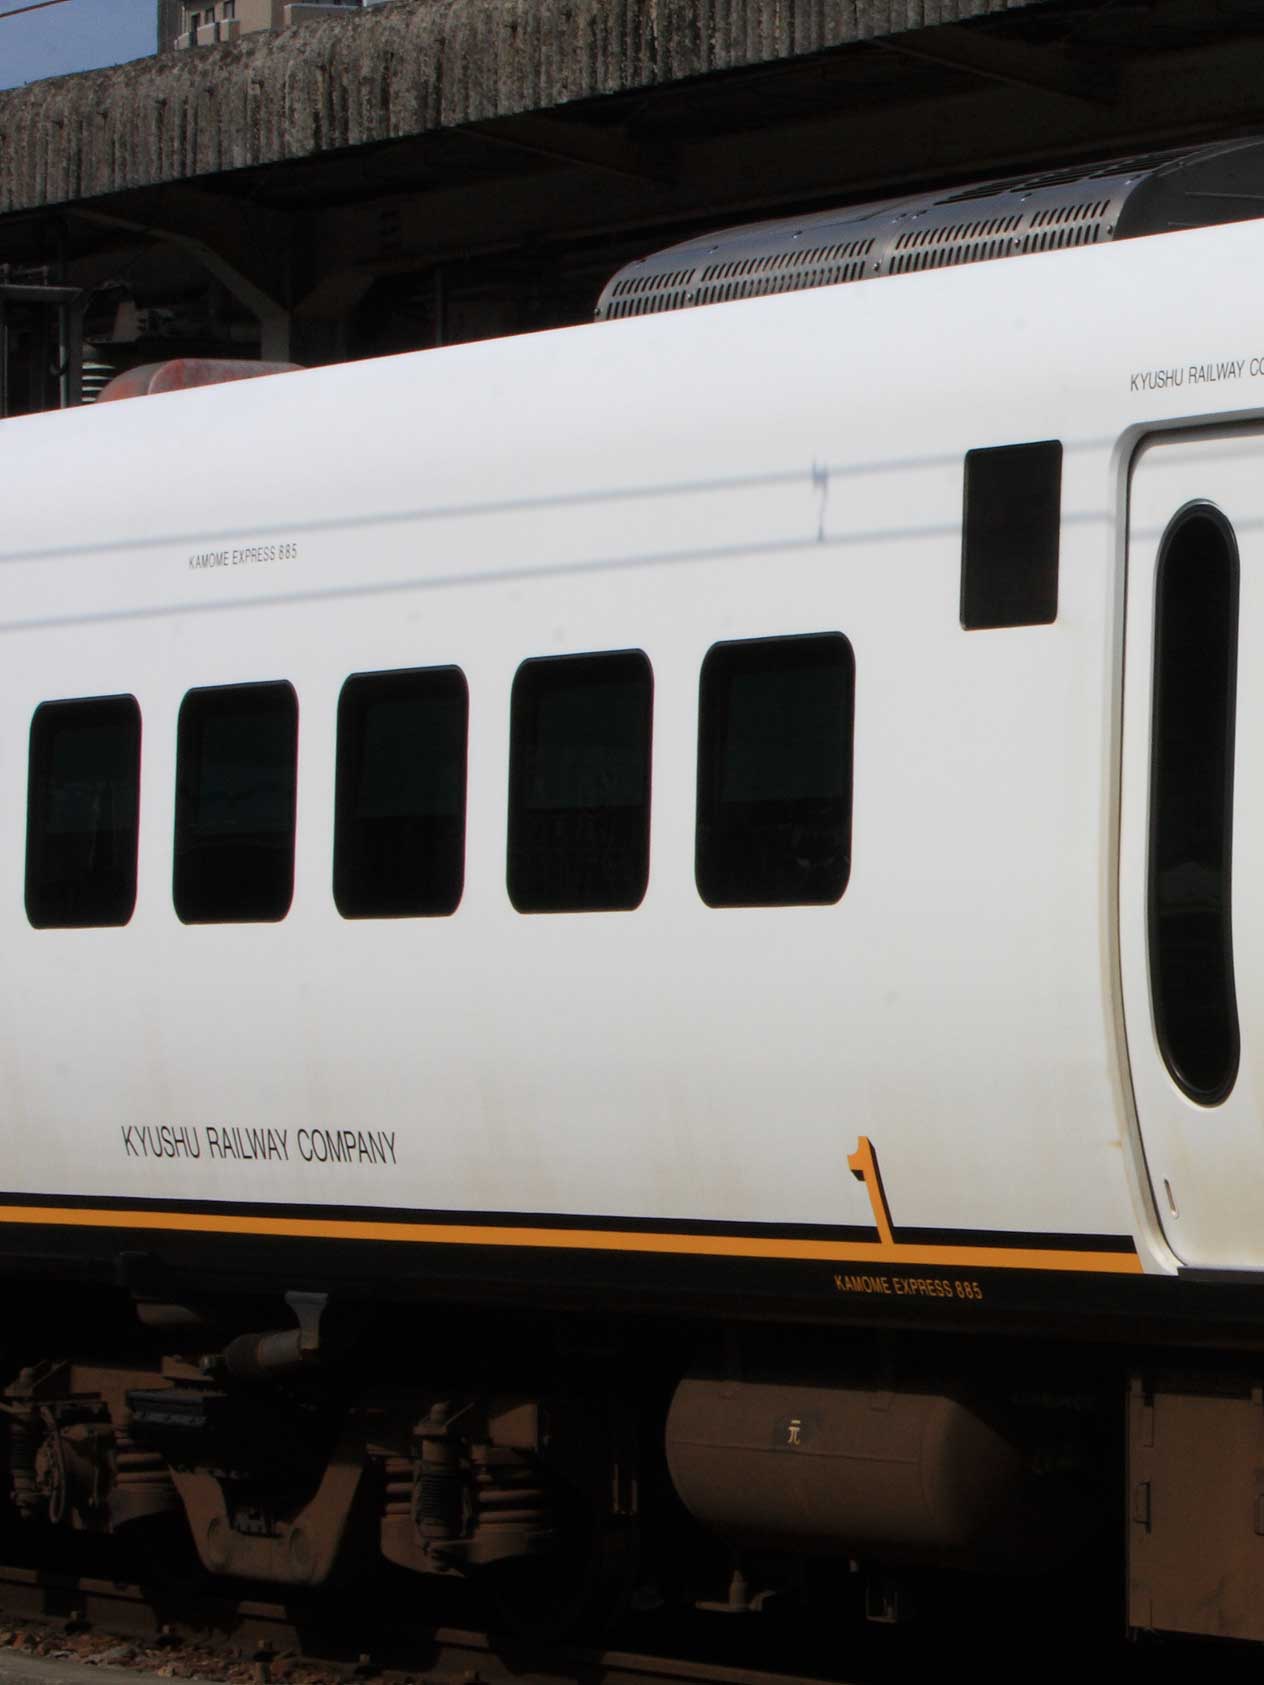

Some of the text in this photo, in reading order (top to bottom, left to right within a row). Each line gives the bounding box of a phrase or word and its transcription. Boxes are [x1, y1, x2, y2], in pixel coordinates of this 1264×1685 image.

[1130, 368, 1184, 392] KYUSHU
[1188, 360, 1245, 384] RAILWAY
[188, 543, 298, 569] KAMOME EXPRESS 885
[121, 1125, 397, 1164] KYUSHU RAILWAY COMPANY
[834, 1275, 983, 1299] KAMOME EXPRESS 885
